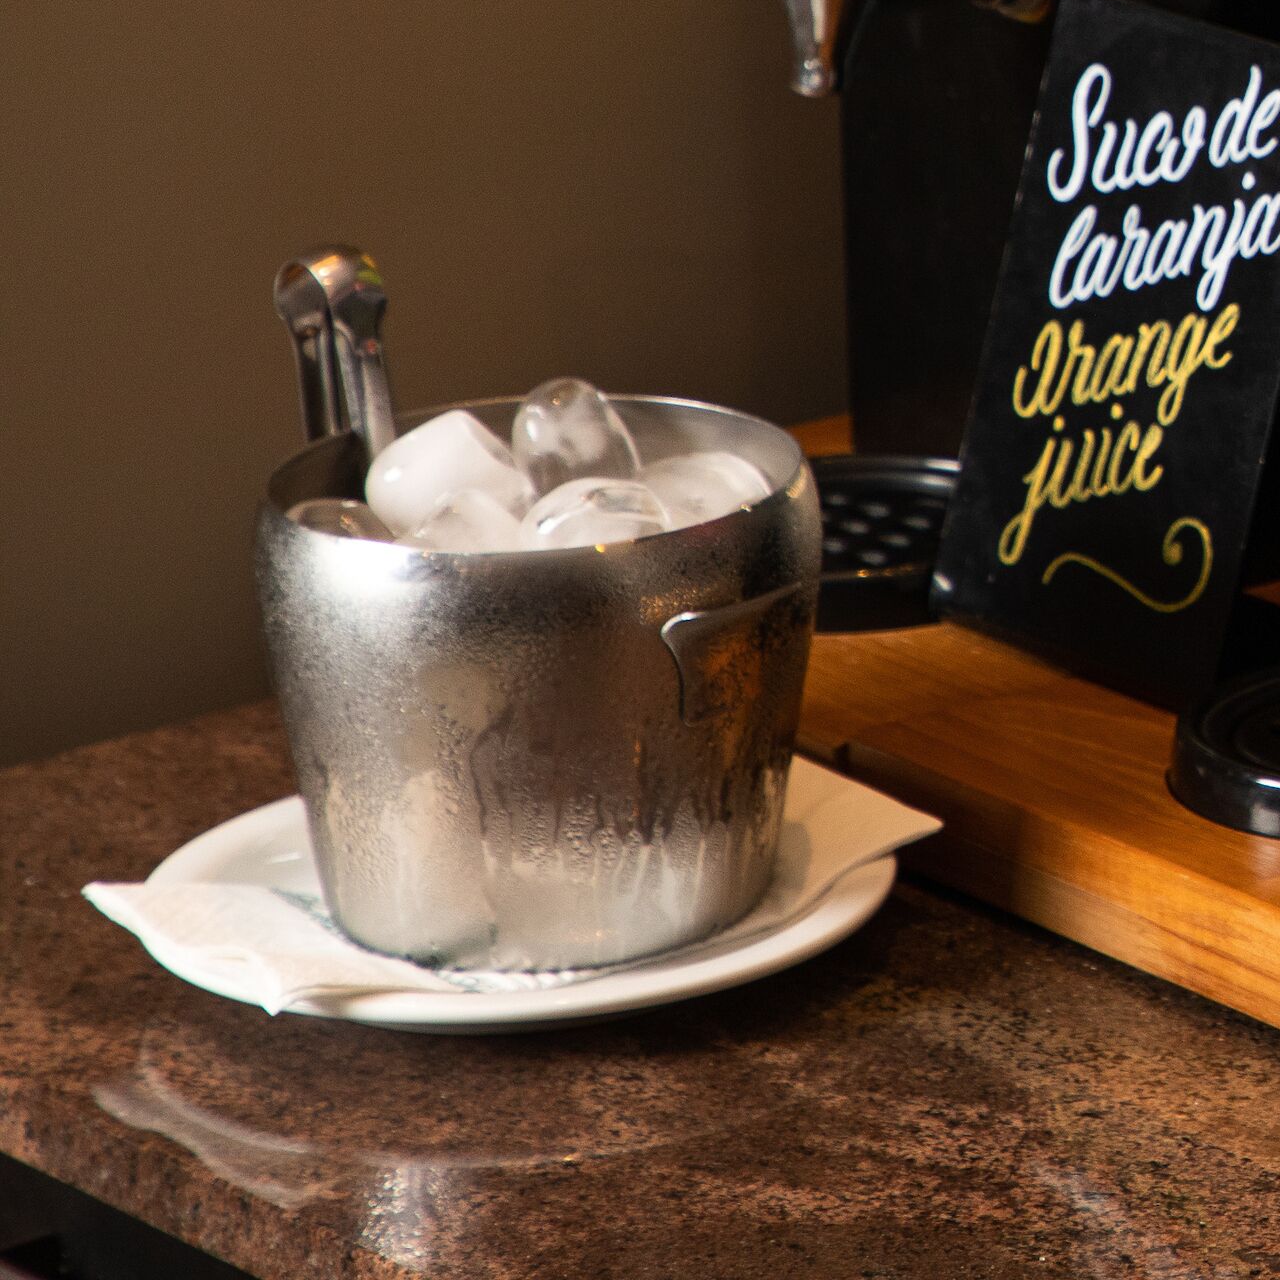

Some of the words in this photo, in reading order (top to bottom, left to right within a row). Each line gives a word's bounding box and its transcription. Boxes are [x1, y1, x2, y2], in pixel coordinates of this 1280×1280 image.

[1047, 63, 1206, 202] Suco
[1013, 304, 1240, 425] Orange
[999, 401, 1163, 565] juice
